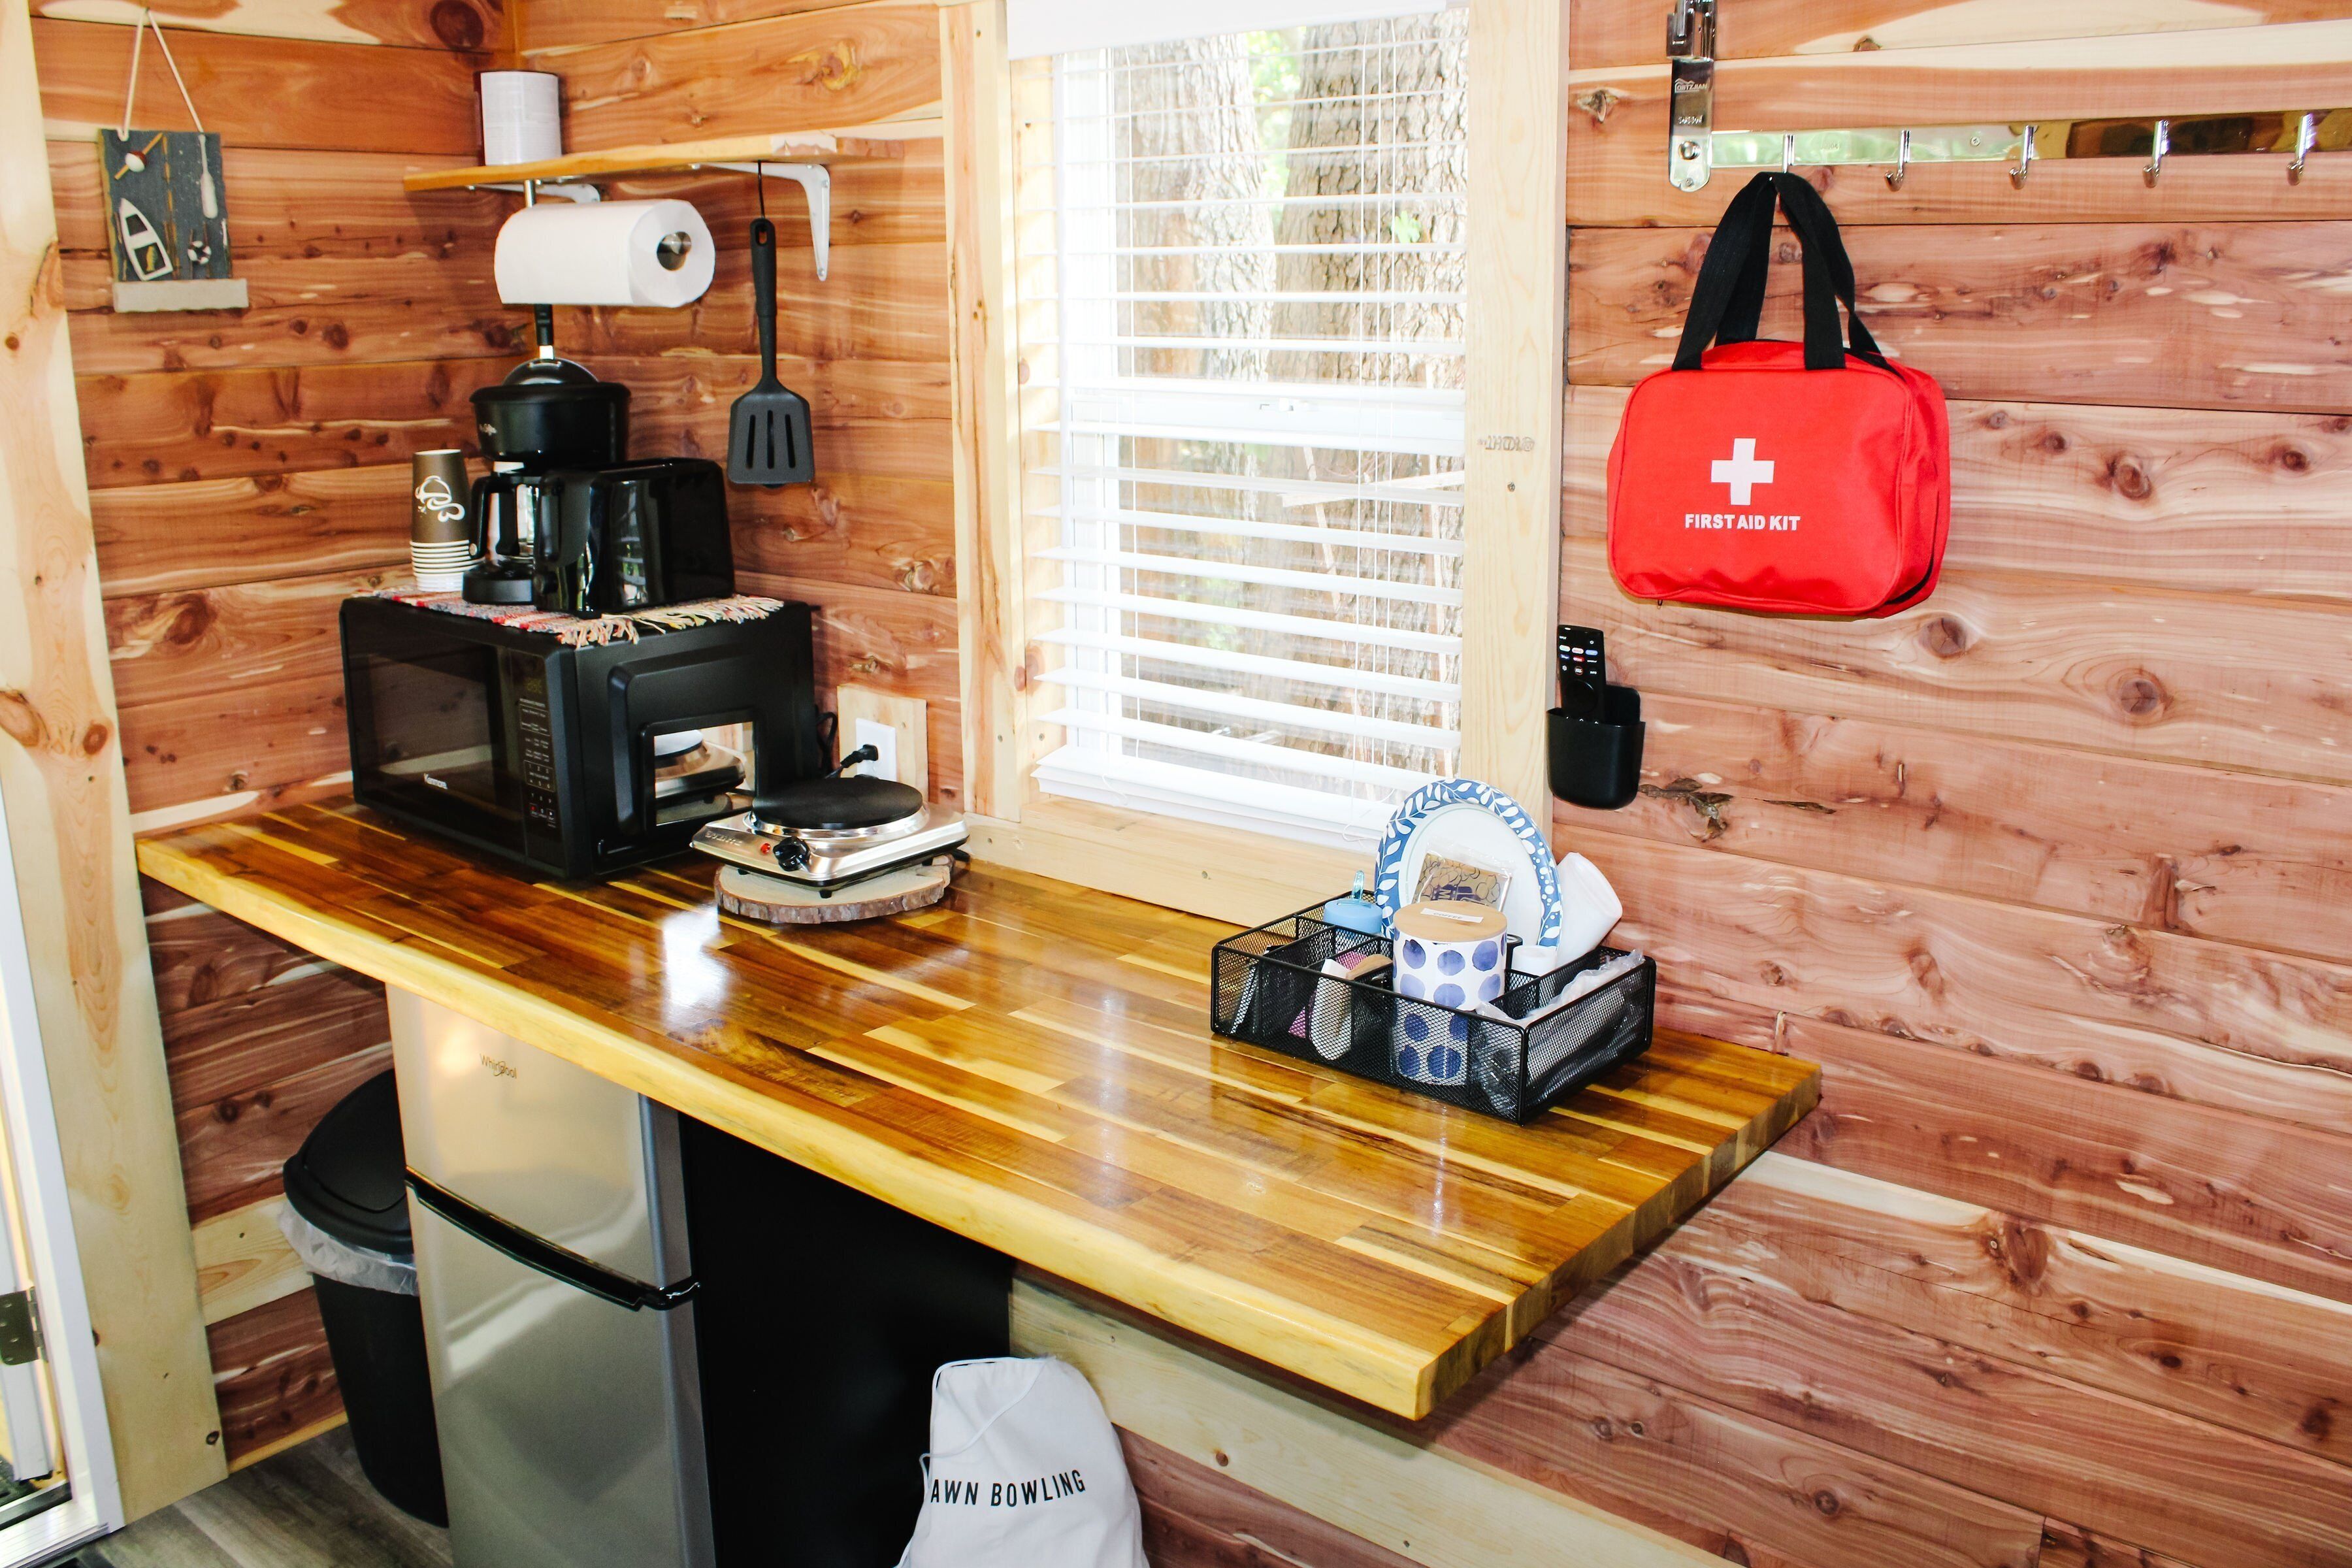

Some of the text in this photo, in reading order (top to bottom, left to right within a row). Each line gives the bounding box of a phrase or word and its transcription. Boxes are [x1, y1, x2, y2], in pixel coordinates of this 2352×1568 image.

[1685, 514, 1801, 531] FIRST AID KIT
[930, 1469, 1086, 1507] AWN BOWLING
